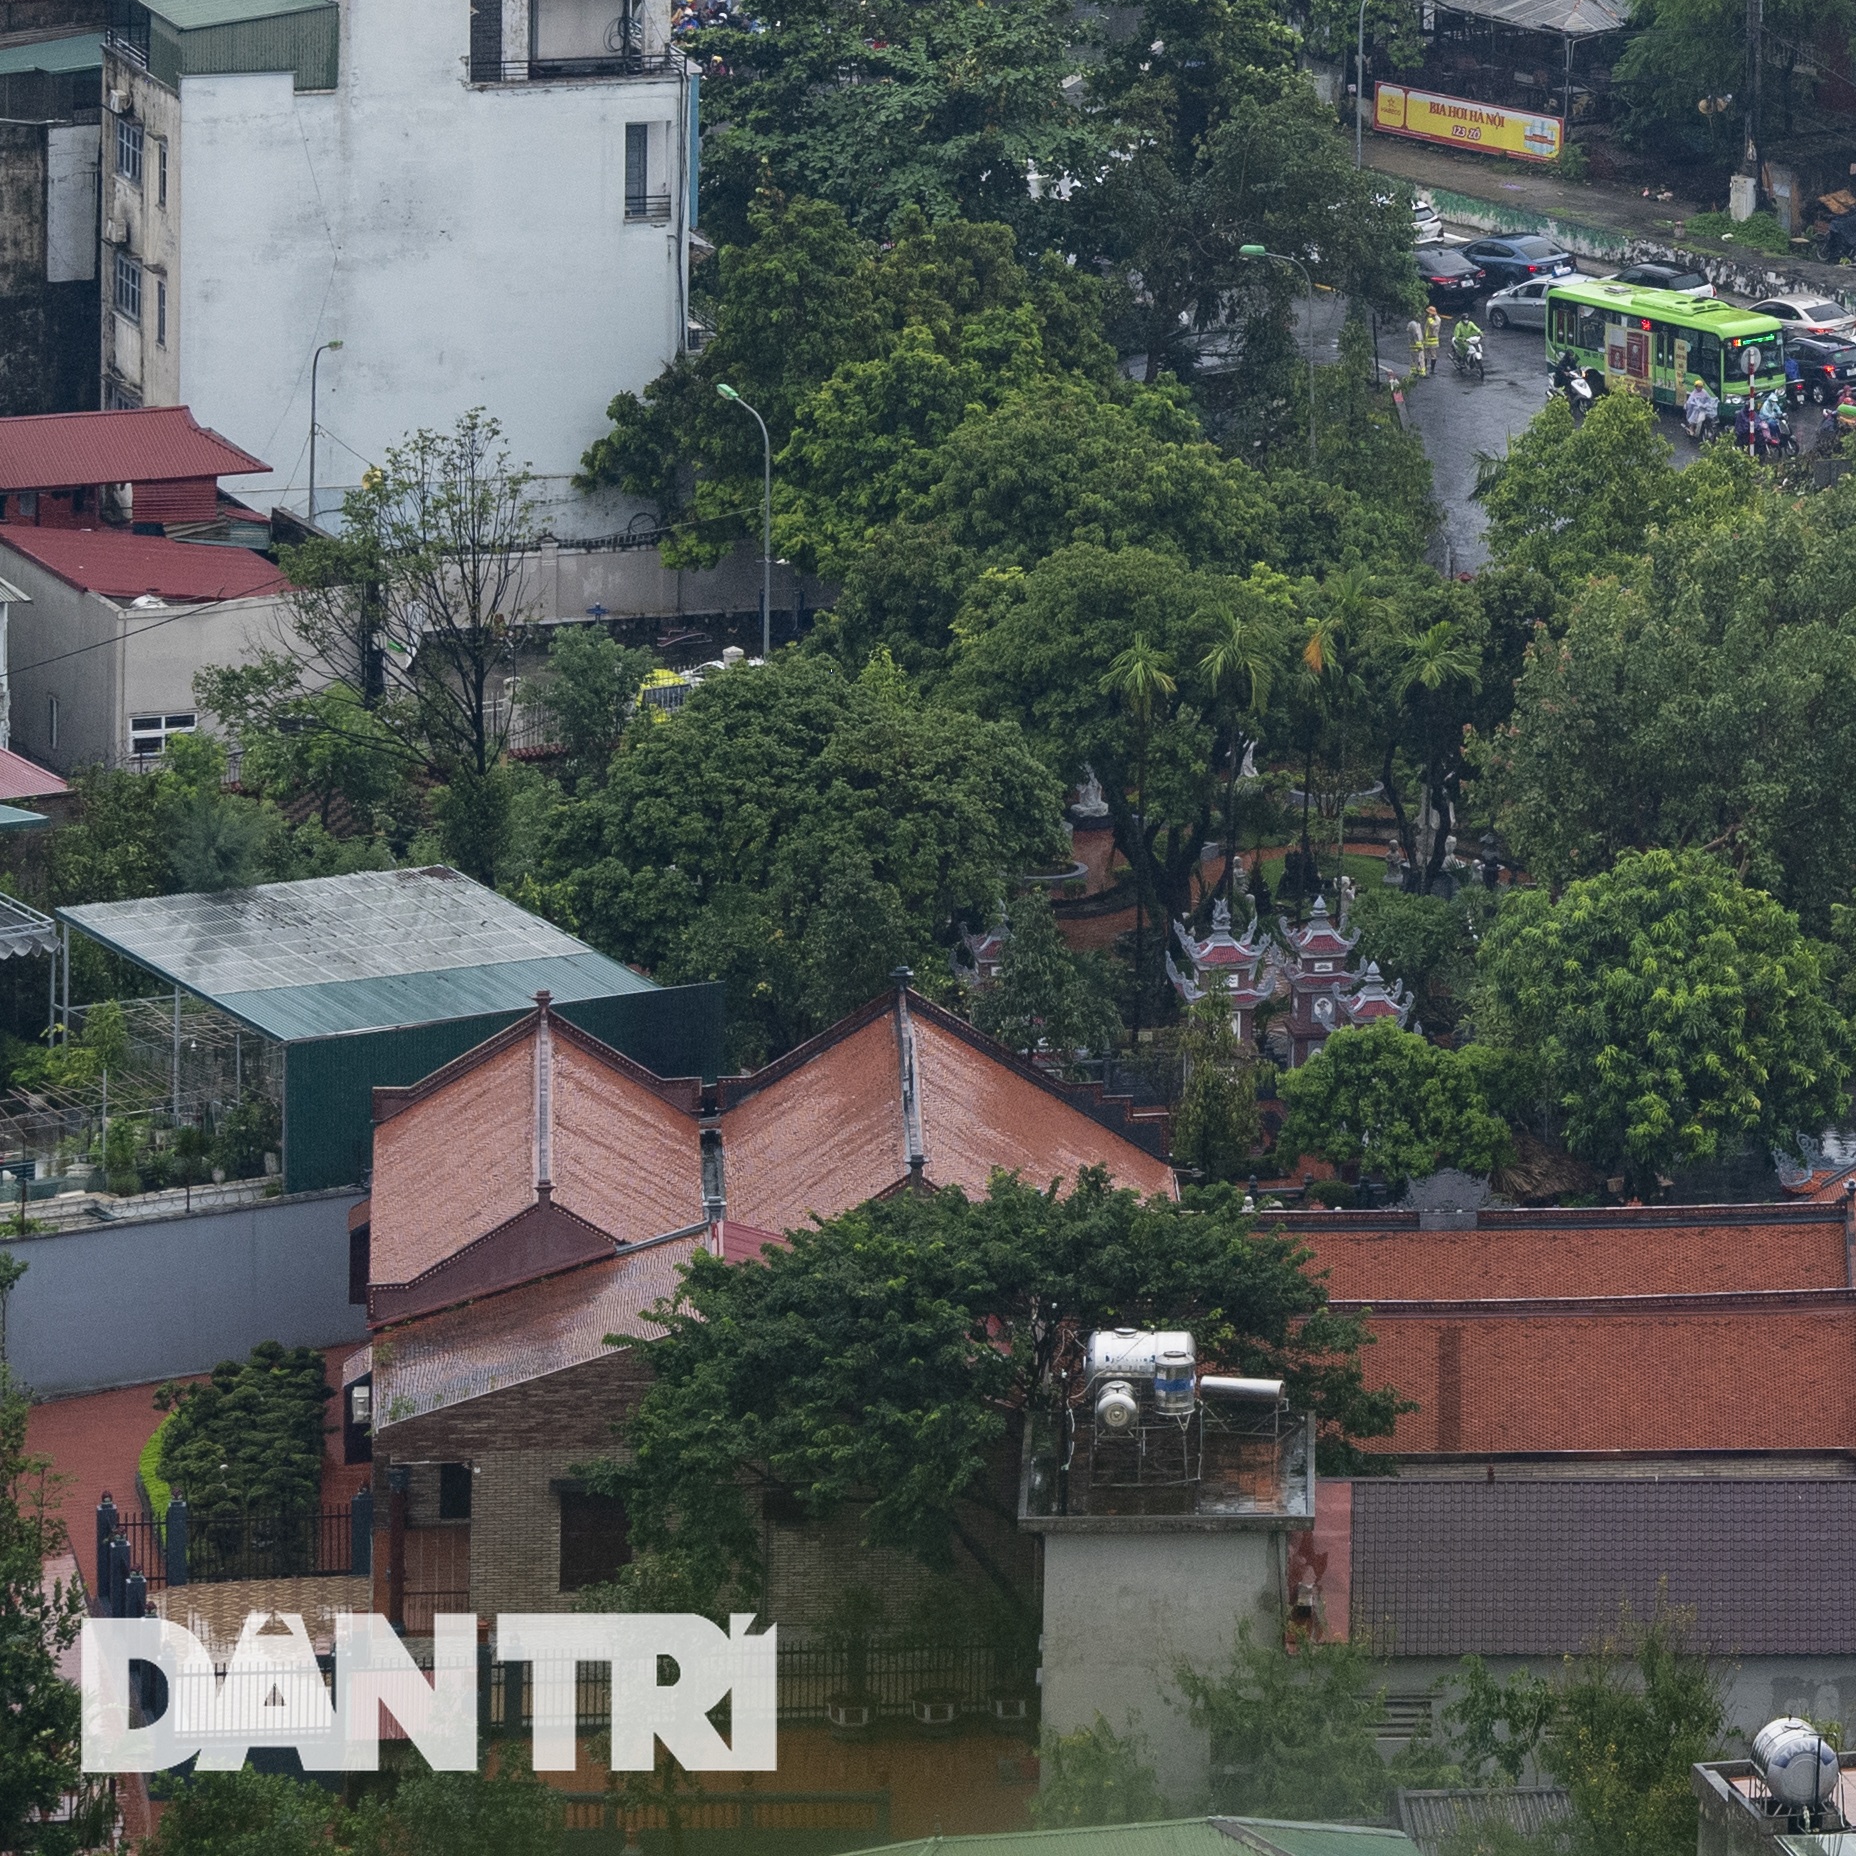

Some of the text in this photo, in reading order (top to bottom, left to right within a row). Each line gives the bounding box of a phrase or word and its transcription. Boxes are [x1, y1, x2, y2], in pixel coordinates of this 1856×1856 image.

[1429, 101, 1446, 115] BIA
[1469, 108, 1485, 124] HÀ
[1486, 113, 1506, 130] NỘI
[1452, 124, 1466, 137] 123
